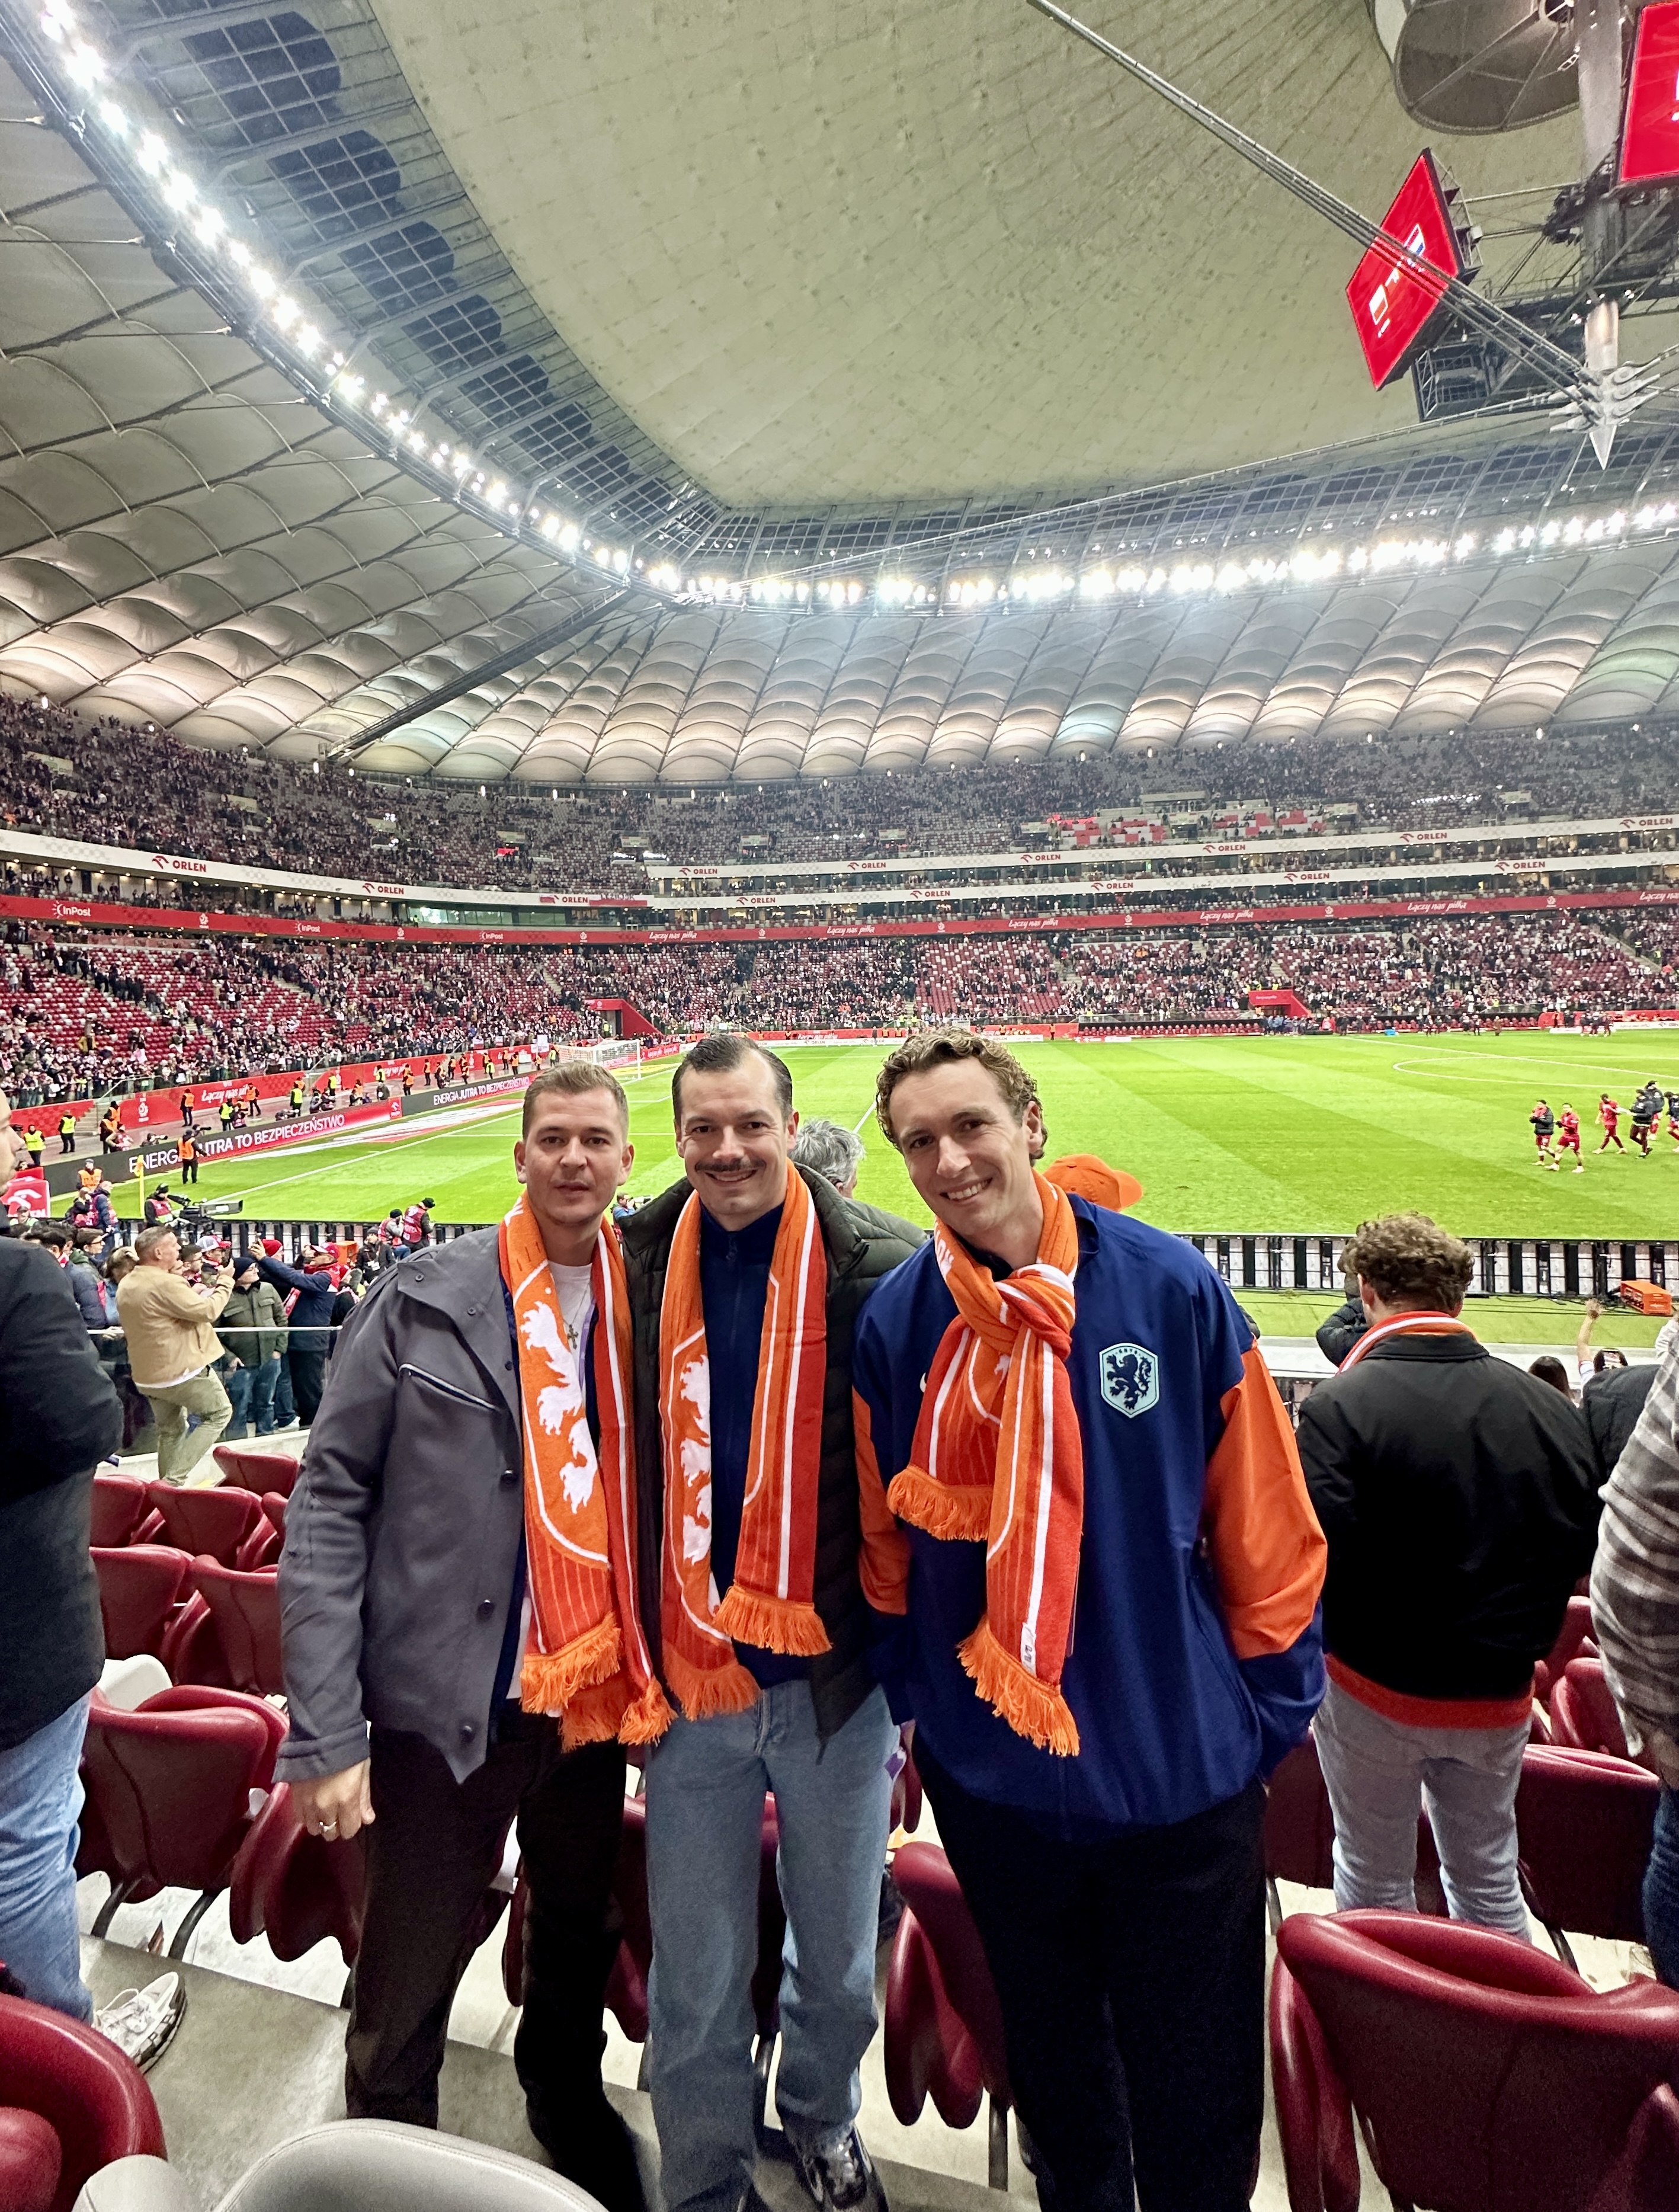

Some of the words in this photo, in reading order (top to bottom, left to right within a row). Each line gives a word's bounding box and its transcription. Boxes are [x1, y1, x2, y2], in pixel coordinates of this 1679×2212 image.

[172, 860, 207, 873] ORLEN
[377, 886, 404, 895] ORLEN
[1639, 892, 1667, 902] Łączy
[63, 906, 91, 917] InPost
[1408, 902, 1431, 912] Łączy
[1446, 901, 1467, 911] piłka
[1200, 911, 1222, 921] Łączy
[1235, 910, 1254, 921] piłka
[302, 924, 321, 933] InPost
[1008, 920, 1028, 929] Łączy
[1041, 918, 1058, 928] piłka
[649, 931, 668, 941] Łączy
[681, 931, 697, 940] piłka
[826, 926, 845, 936] Łączy
[858, 925, 875, 934] piłka
[434, 1090, 459, 1106] ENERGIA
[459, 1087, 479, 1100] JUTRA
[478, 1085, 486, 1095] TO
[486, 1076, 530, 1093] BEZPIECZEŃSTWO
[129, 1148, 182, 1173] ENERG
[237, 1133, 252, 1148] TO
[254, 1113, 345, 1144] BEZPIECZEŃSTWO
